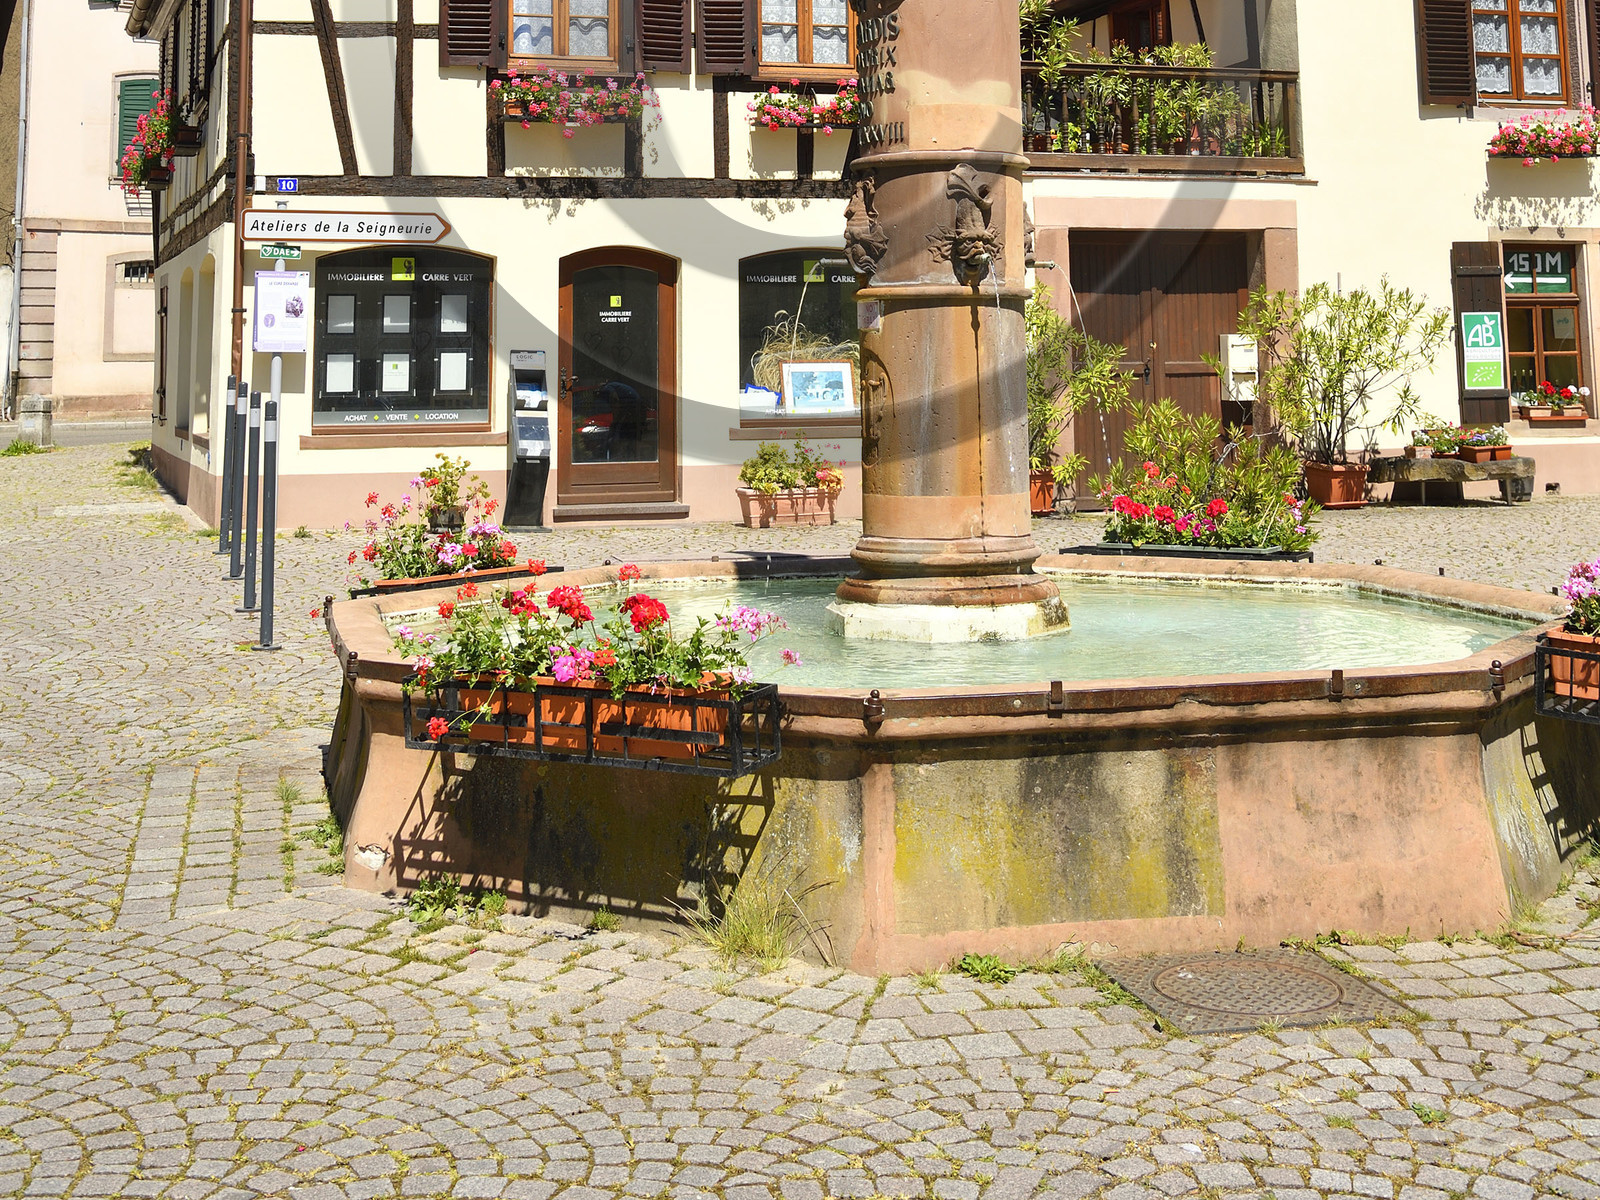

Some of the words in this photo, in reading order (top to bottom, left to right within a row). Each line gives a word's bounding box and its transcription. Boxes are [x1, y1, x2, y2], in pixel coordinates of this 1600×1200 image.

[281, 180, 294, 190] 10
[250, 219, 307, 232] Ateliers
[314, 221, 330, 233] de
[337, 221, 350, 233] la
[356, 221, 432, 236] Seigneurie
[273, 248, 290, 256] DAE
[327, 273, 385, 281] IMMOBILIERE
[422, 273, 450, 281] CARRE
[453, 273, 474, 281] VERT
[746, 275, 797, 283] IMMOBILIERE
[831, 275, 856, 283] CARRE
[1467, 324, 1496, 347] AB
